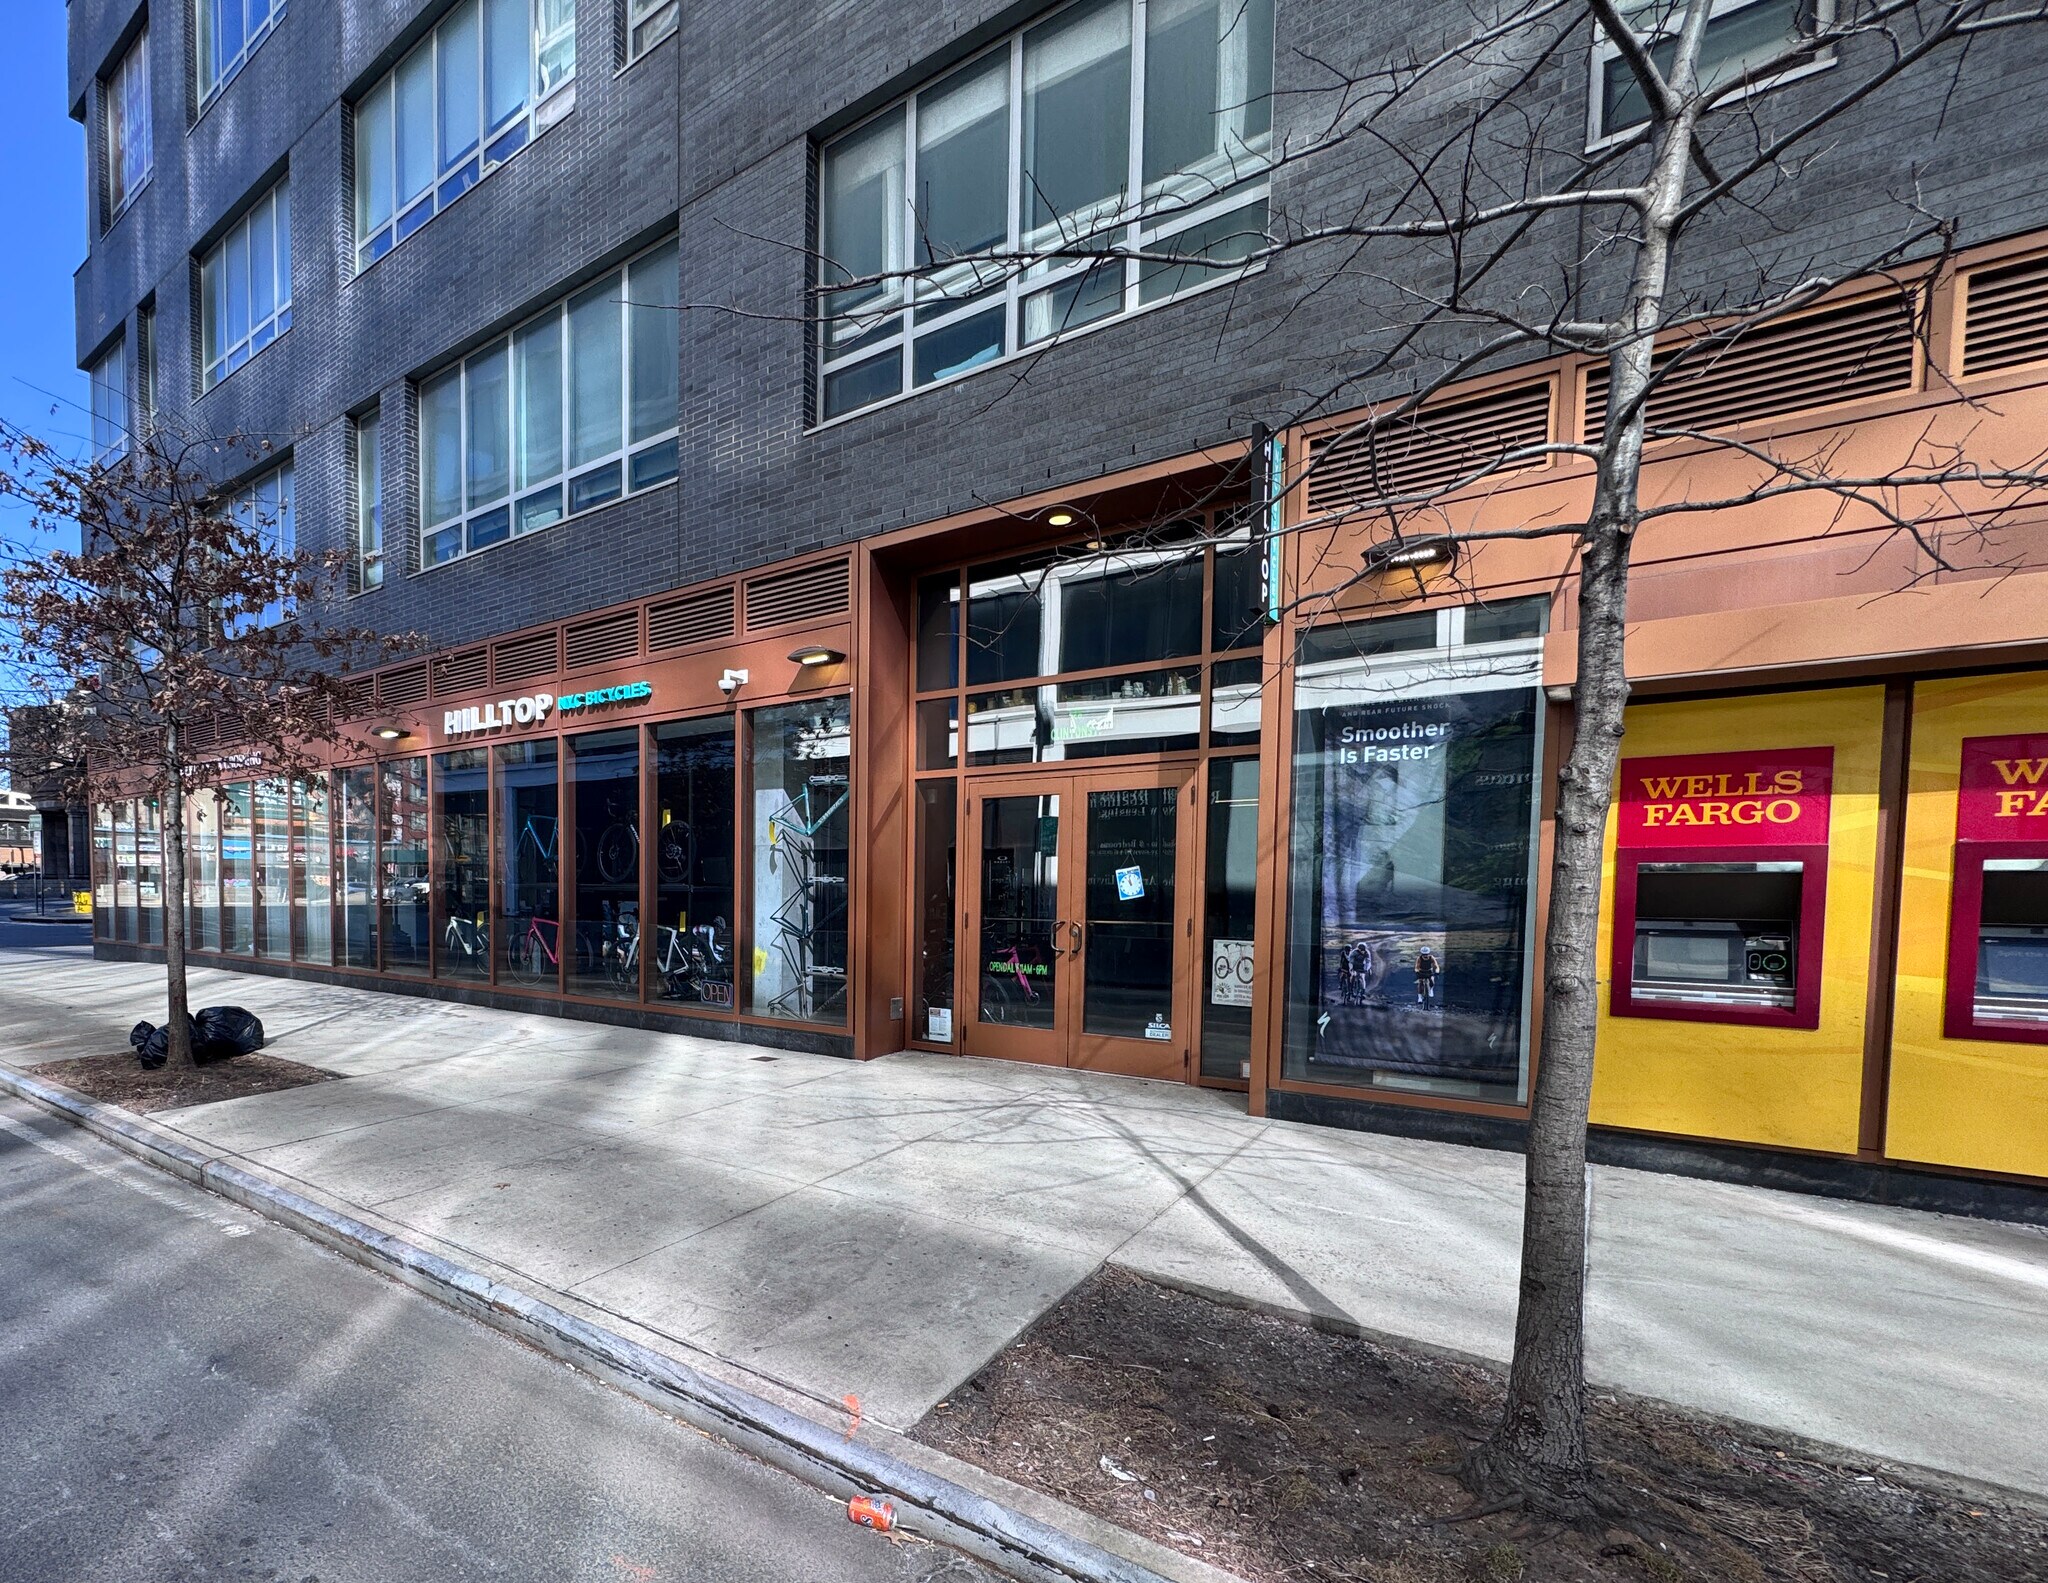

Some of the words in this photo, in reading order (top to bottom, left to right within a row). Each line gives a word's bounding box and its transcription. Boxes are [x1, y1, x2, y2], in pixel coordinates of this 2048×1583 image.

[1261, 436, 1271, 602] HILLTOP
[444, 694, 553, 734] HILLTOP
[558, 694, 586, 710] NYC
[585, 681, 652, 706] BICYCLES
[1385, 705, 1418, 713] FUTURE
[1421, 703, 1451, 711] SHOCK
[1341, 721, 1451, 743] Smoother
[1340, 748, 1358, 764] Is
[1364, 745, 1435, 763] Faster
[1640, 770, 1803, 799] WELLS
[1642, 799, 1801, 827] FARGO
[702, 982, 730, 1003] OPEN
